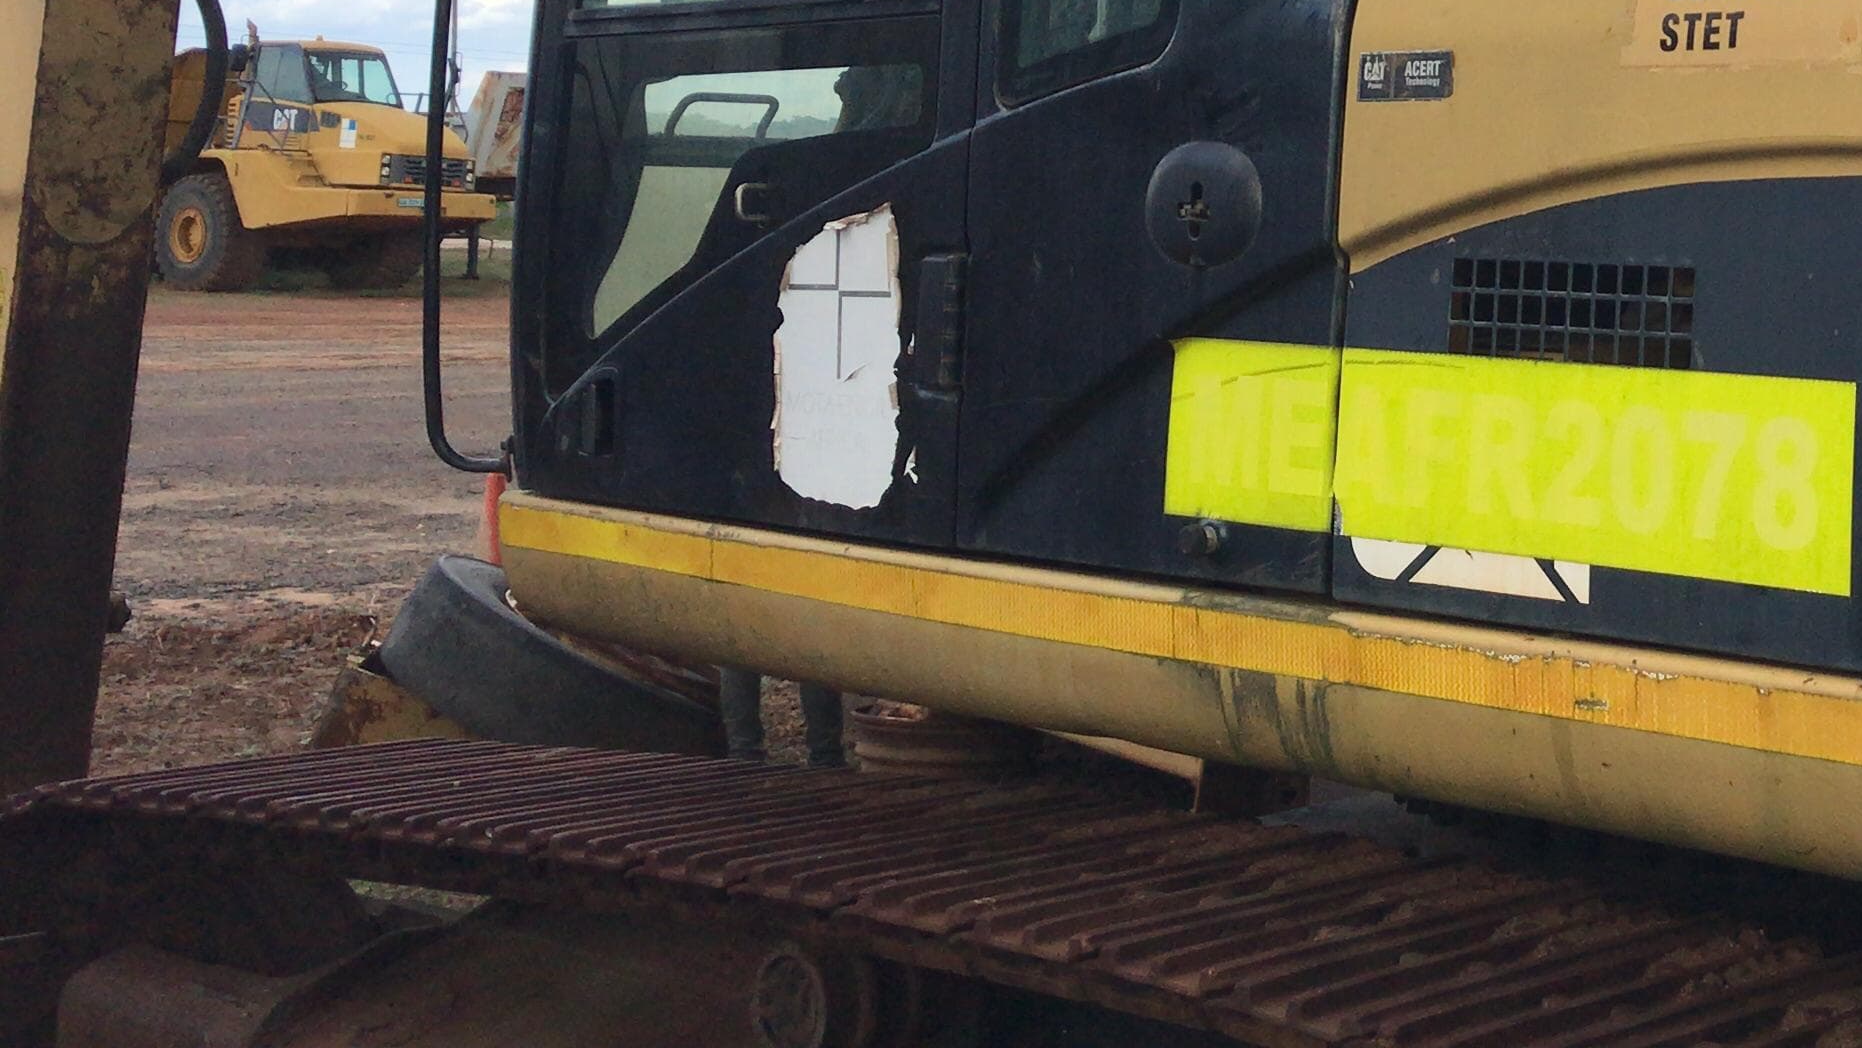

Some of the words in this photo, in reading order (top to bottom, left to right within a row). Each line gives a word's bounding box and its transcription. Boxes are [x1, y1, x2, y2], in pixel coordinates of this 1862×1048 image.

[1659, 10, 1745, 52] STET
[1363, 60, 1386, 81] CAT
[1404, 60, 1441, 77] ACERT
[273, 108, 298, 130] CAT
[1187, 372, 1820, 552] MEAFR2078
